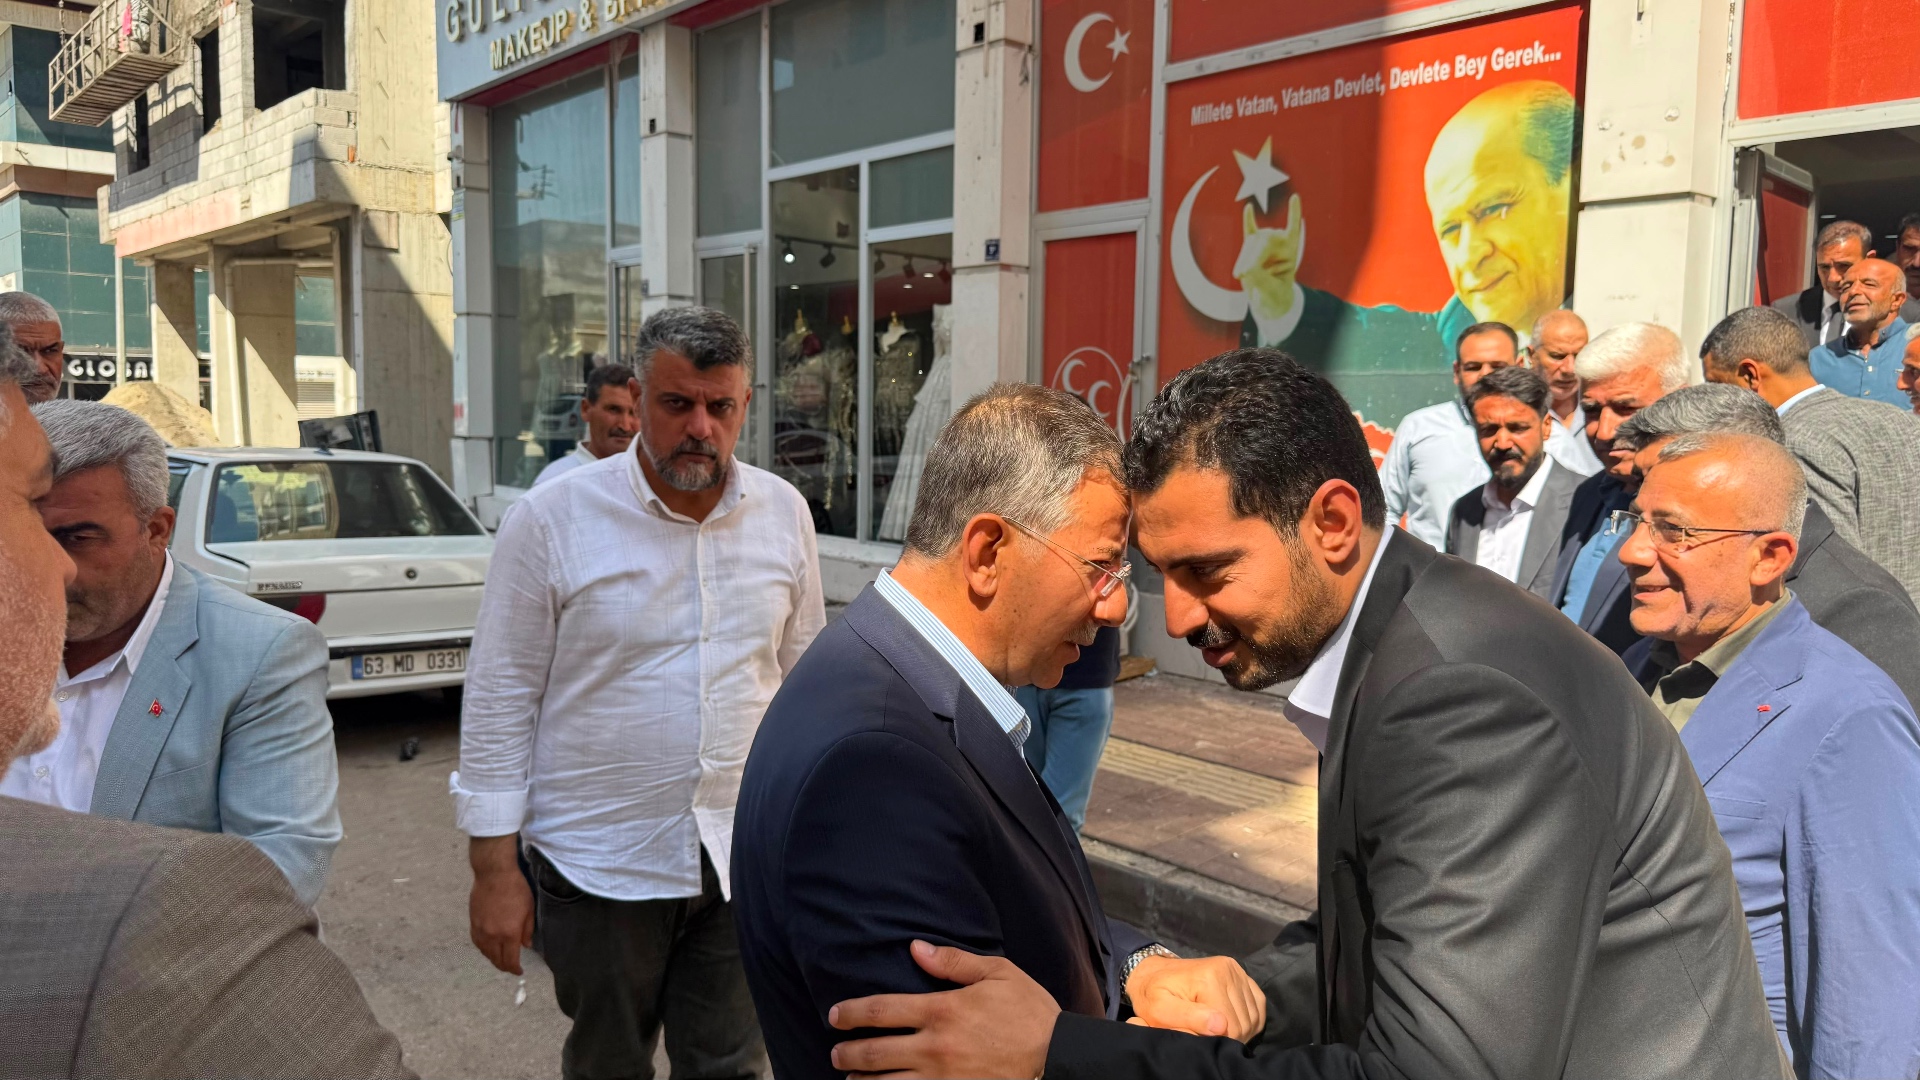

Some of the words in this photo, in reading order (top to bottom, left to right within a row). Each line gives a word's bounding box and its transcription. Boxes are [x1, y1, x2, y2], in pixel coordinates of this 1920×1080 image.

[490, 8, 568, 70] MAKEUP
[579, 0, 592, 32] &
[1190, 102, 1233, 126] Millete
[1236, 95, 1278, 118] Vatan,
[1281, 85, 1331, 109] Vatana
[1334, 71, 1385, 100] Devlet,
[1389, 60, 1450, 90] Devlete
[1454, 54, 1487, 80] Bey
[1490, 40, 1562, 71] Gerek...
[67, 358, 153, 378] GLOA
[364, 656, 384, 675] 63
[393, 654, 414, 673] MD
[427, 651, 463, 670] 0331
